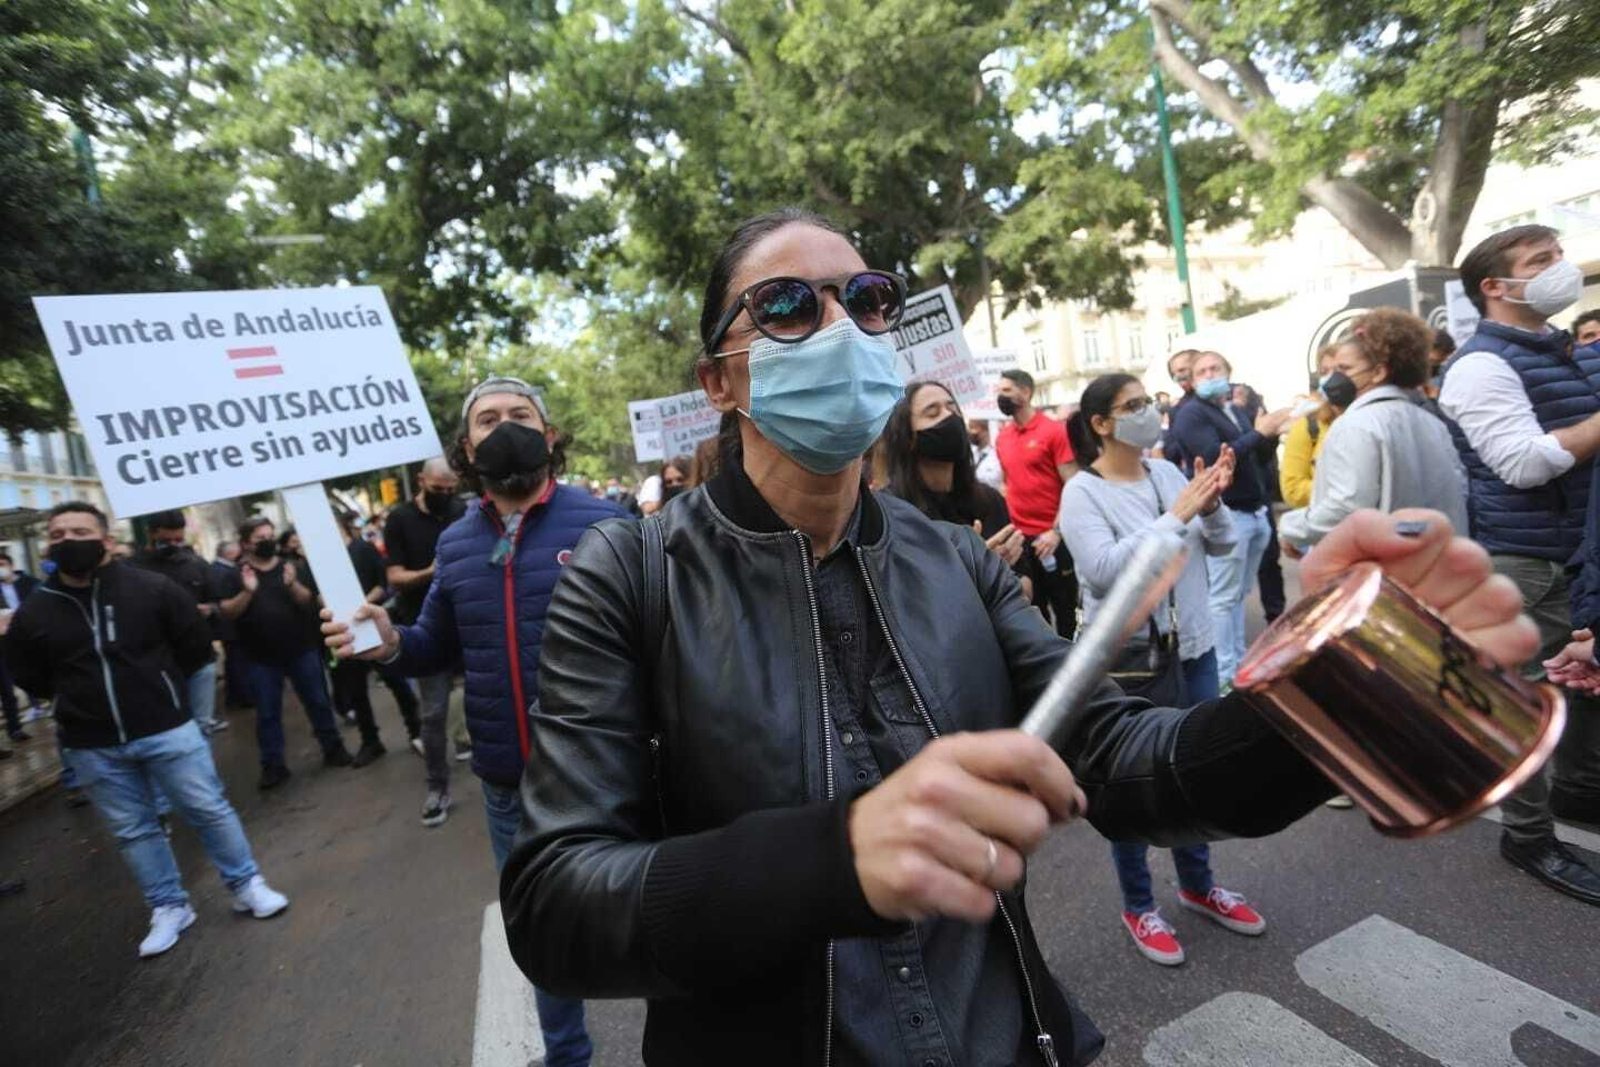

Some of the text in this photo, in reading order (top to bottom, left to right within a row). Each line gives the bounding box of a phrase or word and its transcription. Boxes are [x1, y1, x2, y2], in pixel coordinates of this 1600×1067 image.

[63, 304, 382, 356] Junta de Andalucía
[97, 375, 410, 445] IMPROVISACIÓN
[117, 413, 423, 485] Cierre sin ayudas
